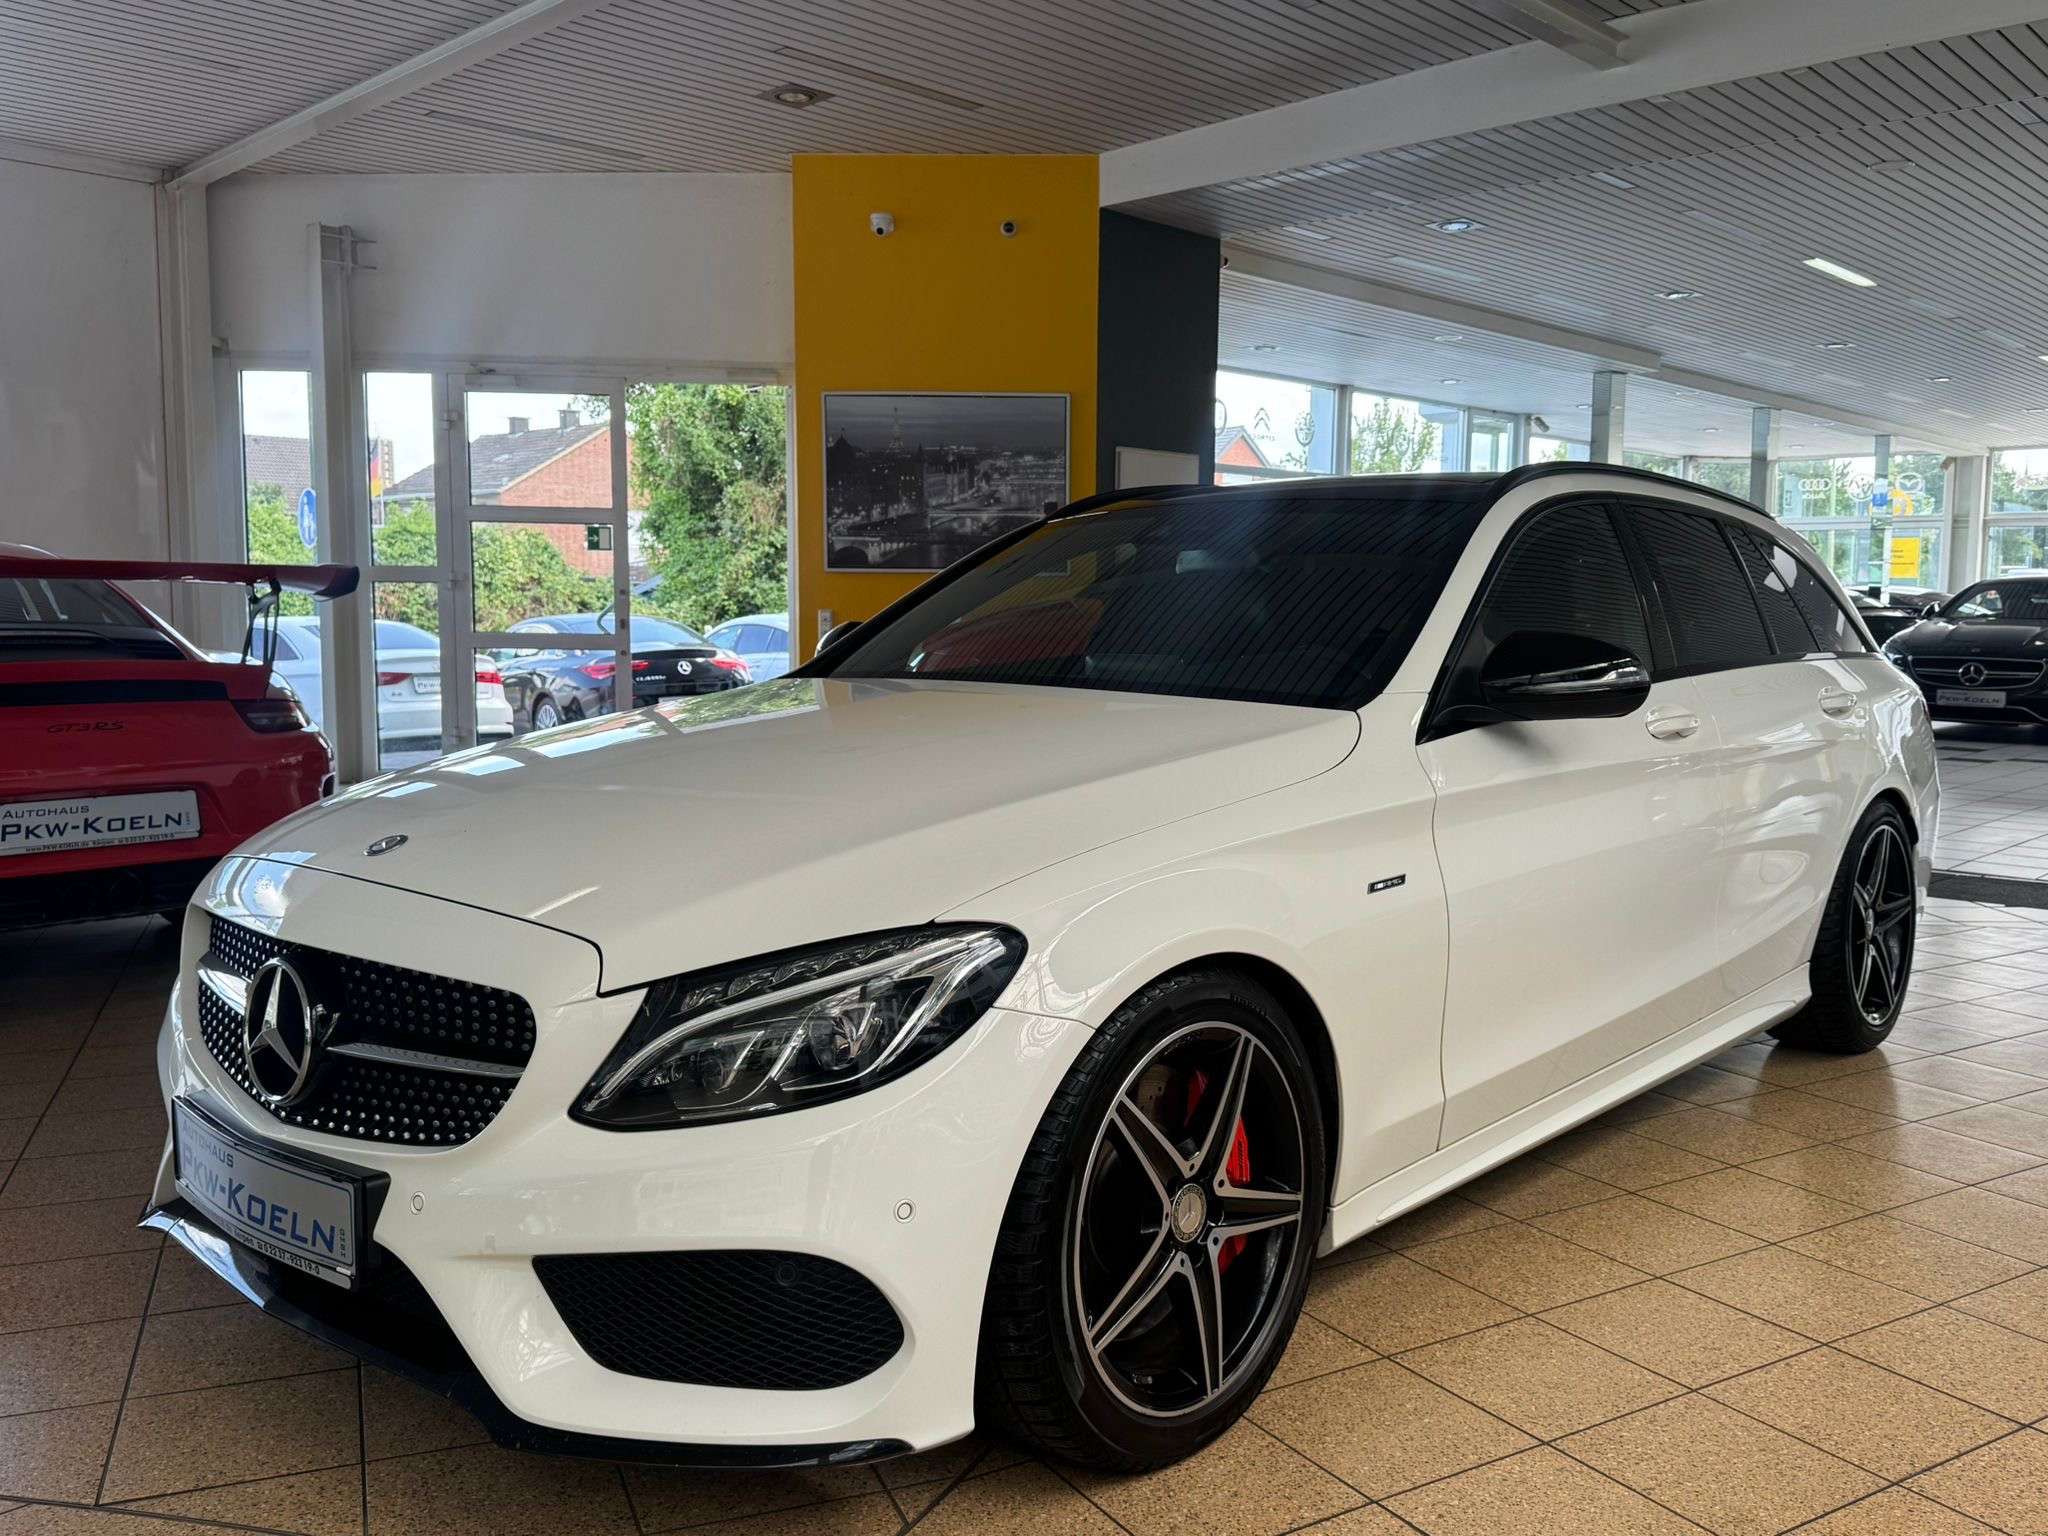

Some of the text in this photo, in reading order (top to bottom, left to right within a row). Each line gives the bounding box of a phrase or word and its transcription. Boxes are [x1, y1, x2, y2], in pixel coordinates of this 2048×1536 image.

[1, 812, 183, 842] PKW-KOELN
[2, 805, 90, 819] AUTOHAUS
[182, 1119, 234, 1168] AUTOHAUS
[182, 1143, 336, 1253] PKW-KOELN
